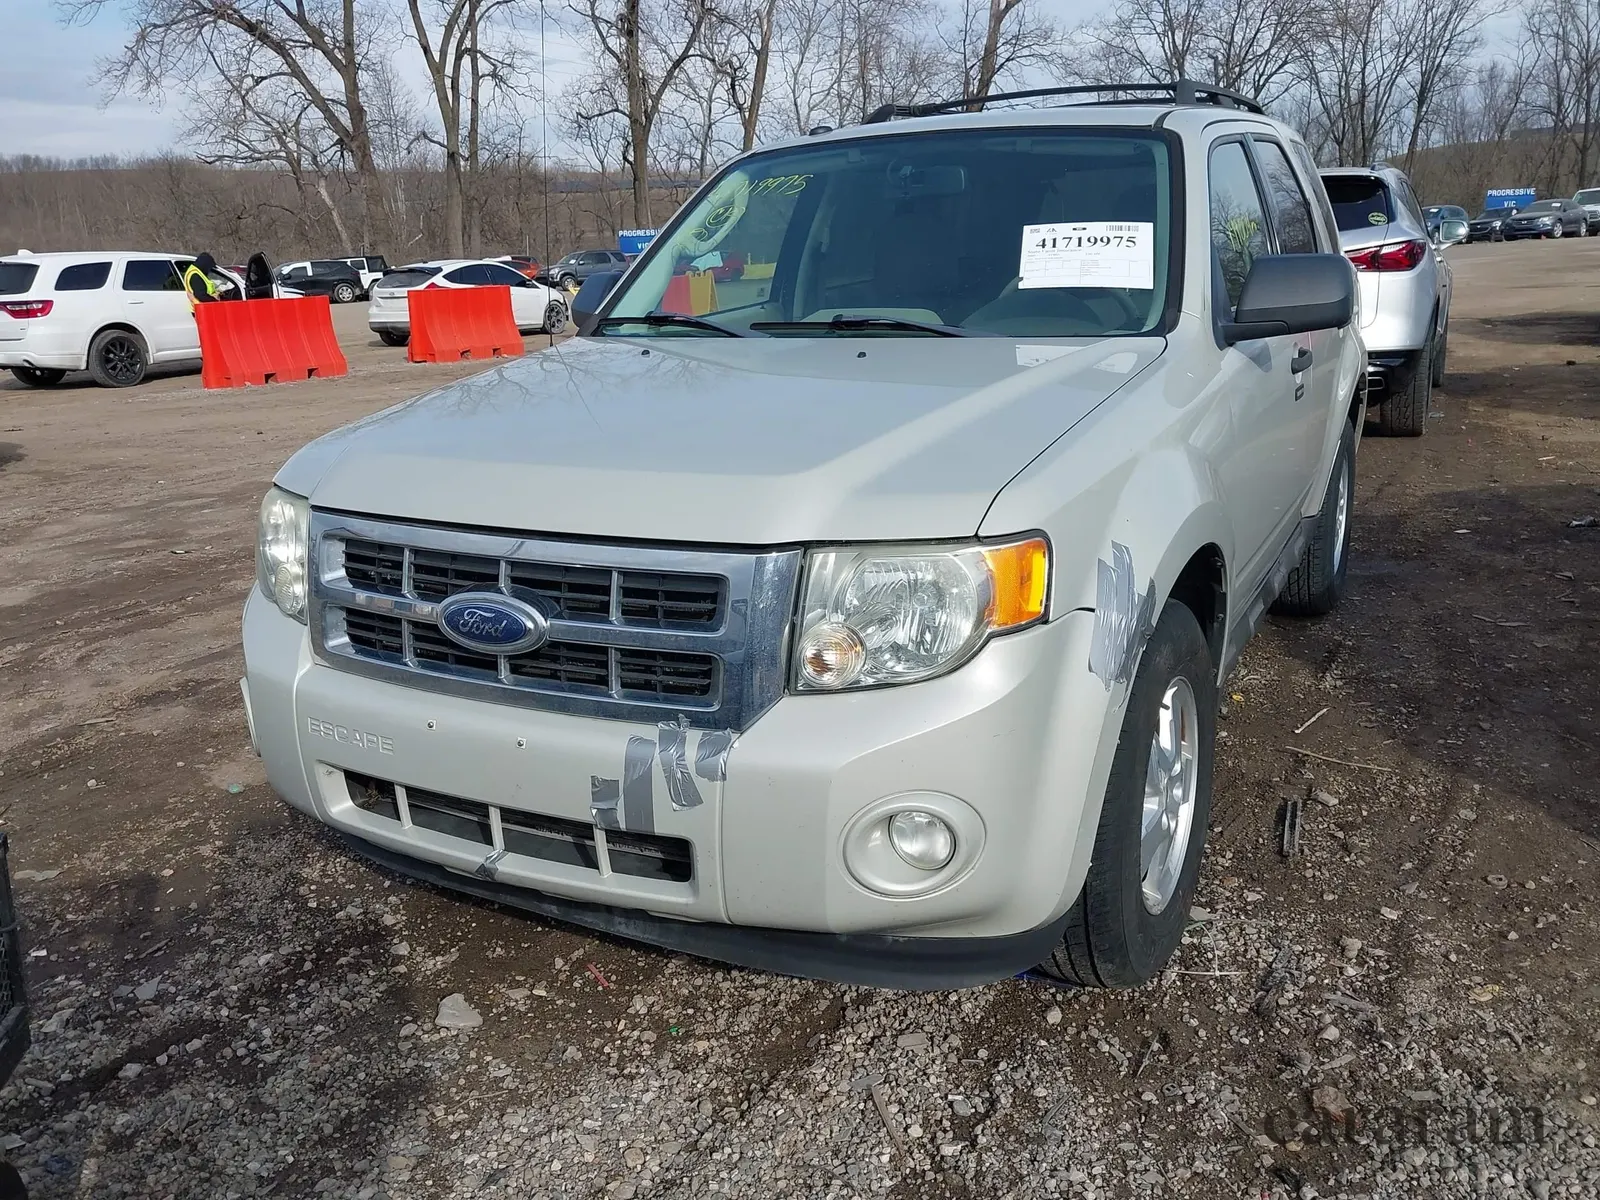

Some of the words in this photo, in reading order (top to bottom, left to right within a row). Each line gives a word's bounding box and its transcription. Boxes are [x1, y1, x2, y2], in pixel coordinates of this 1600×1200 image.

[1487, 187, 1536, 197] PROGRESSIVE
[1503, 200, 1517, 208] VIC
[1035, 235, 1137, 249] 41719975
[458, 609, 508, 638] Ford
[307, 716, 395, 755] ESCAPE
